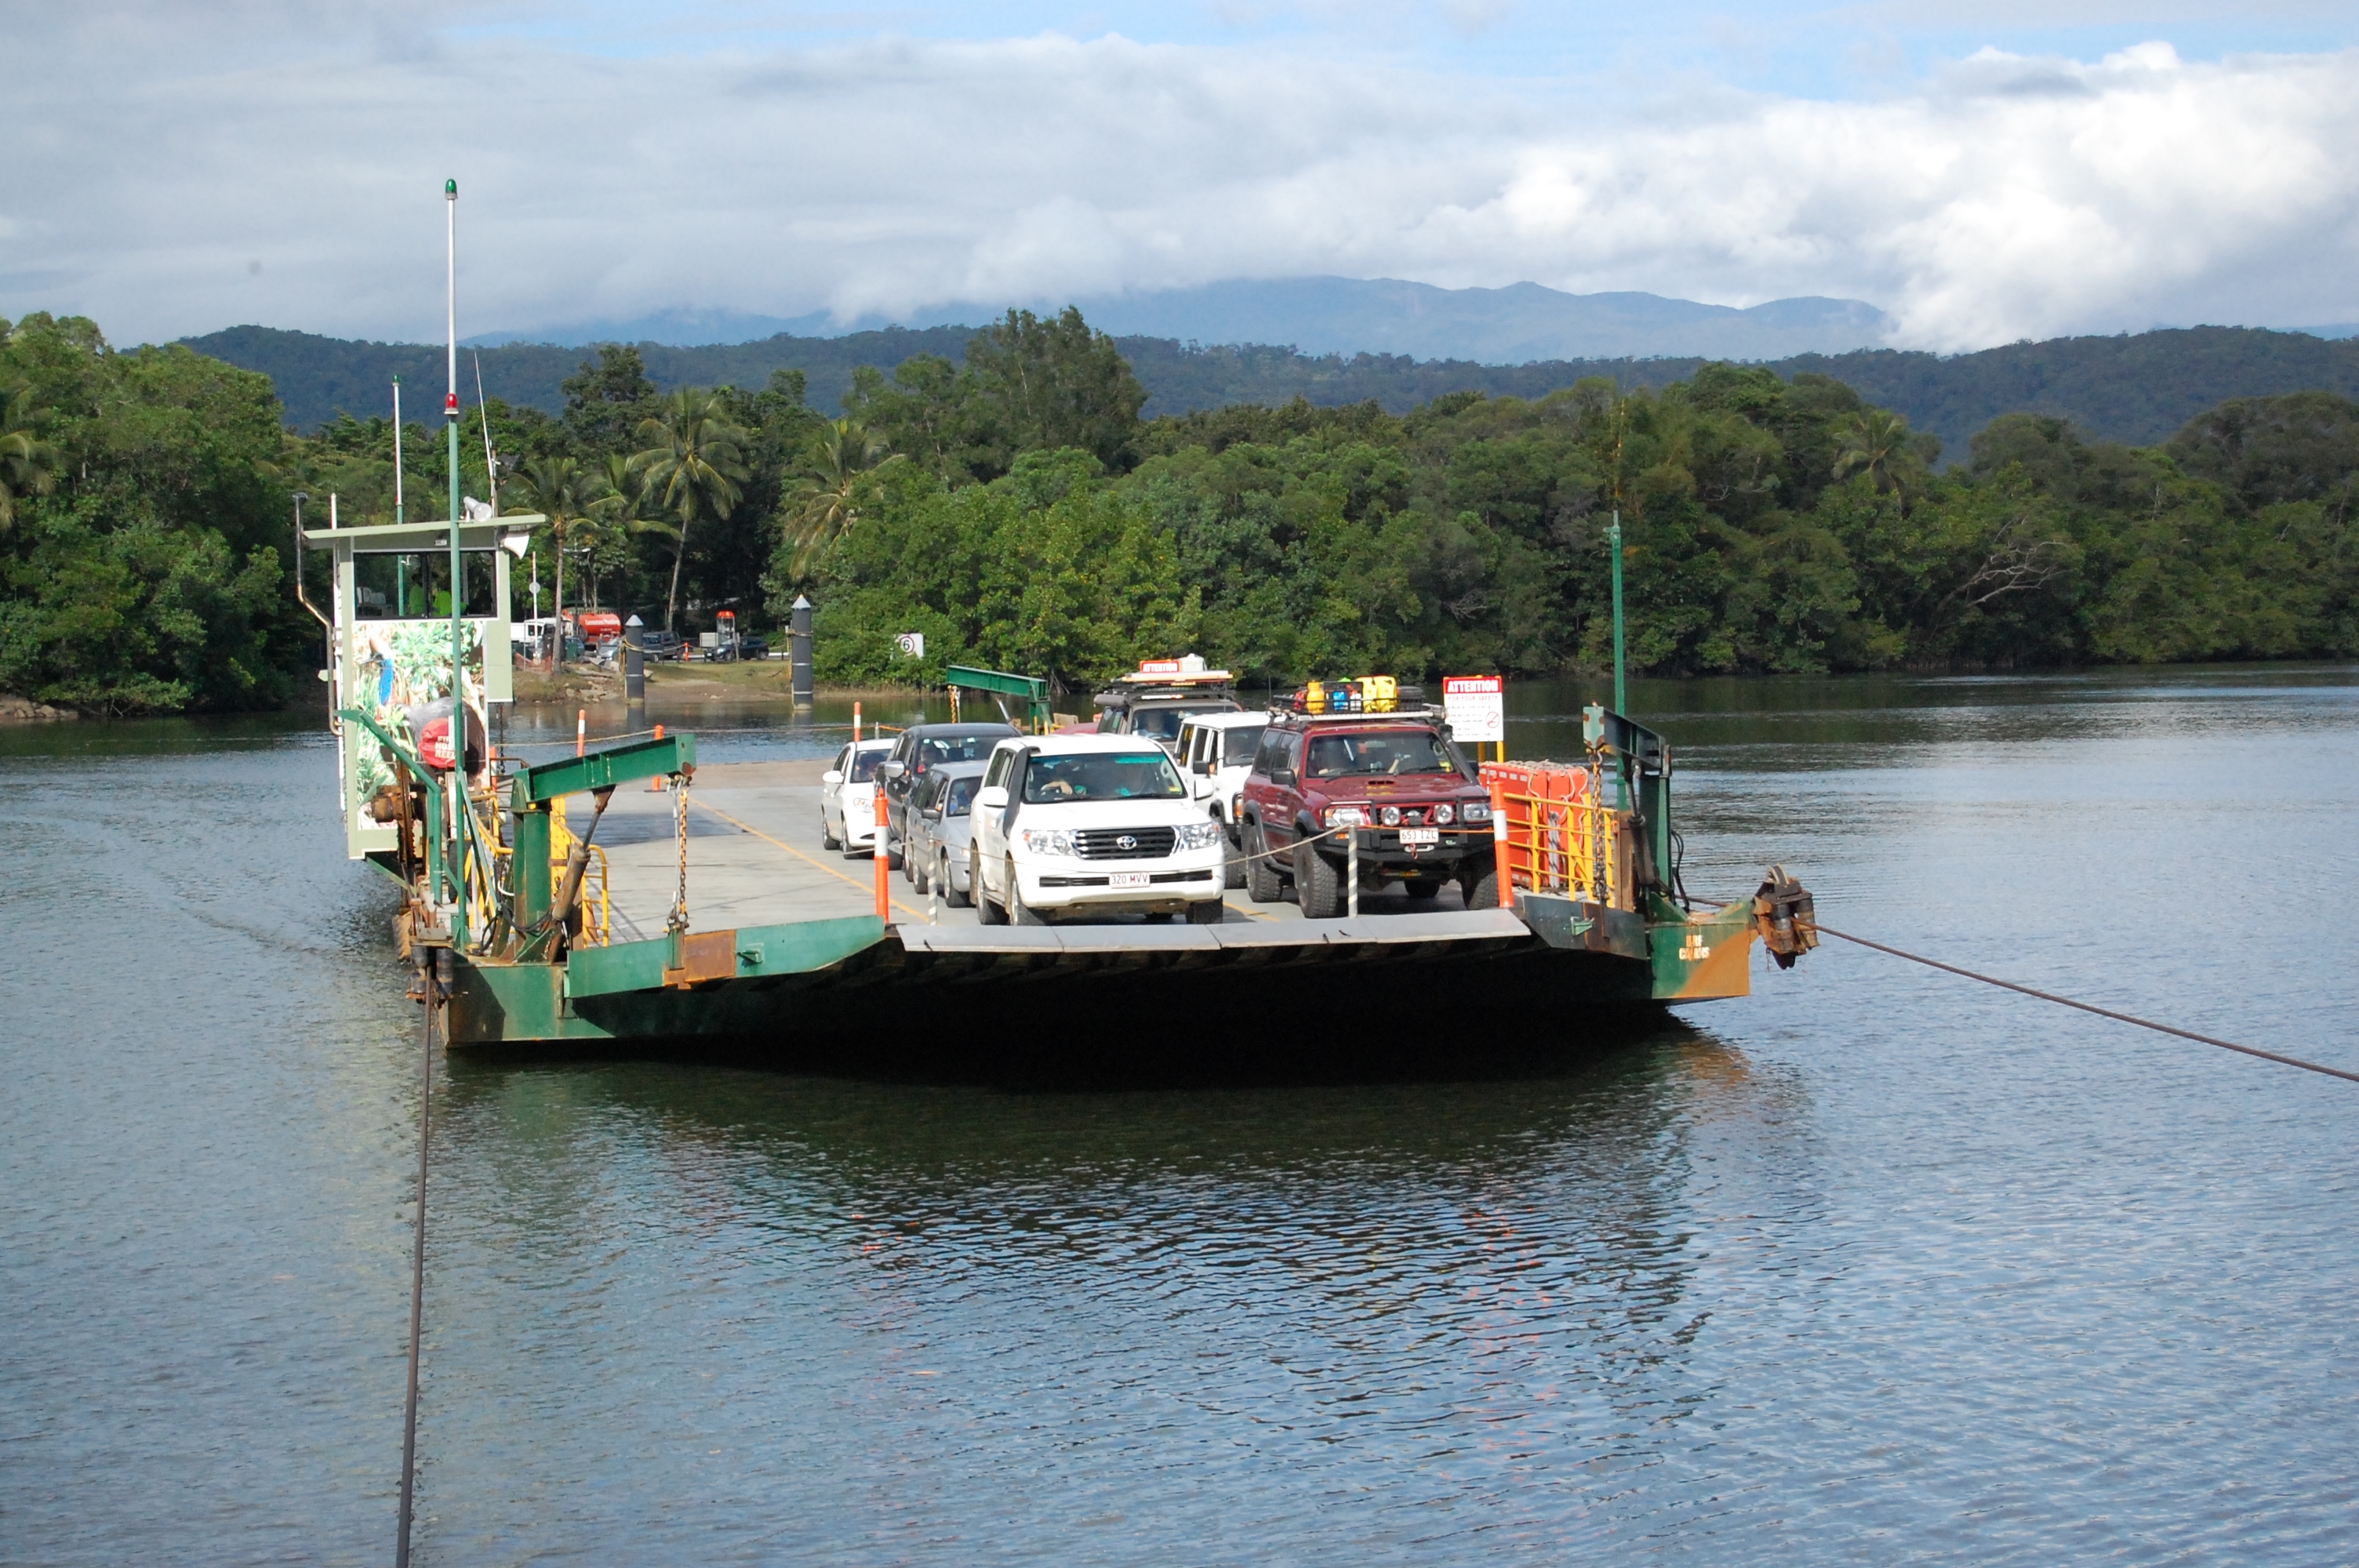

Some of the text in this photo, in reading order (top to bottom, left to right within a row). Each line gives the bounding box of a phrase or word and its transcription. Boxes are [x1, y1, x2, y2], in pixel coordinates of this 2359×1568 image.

[903, 640, 910, 650] 6
[1143, 662, 1178, 672] ATTENTION
[1448, 680, 1499, 693] ATTENTION
[1401, 830, 1416, 840] 653
[1111, 873, 1147, 884] 320 MVV
